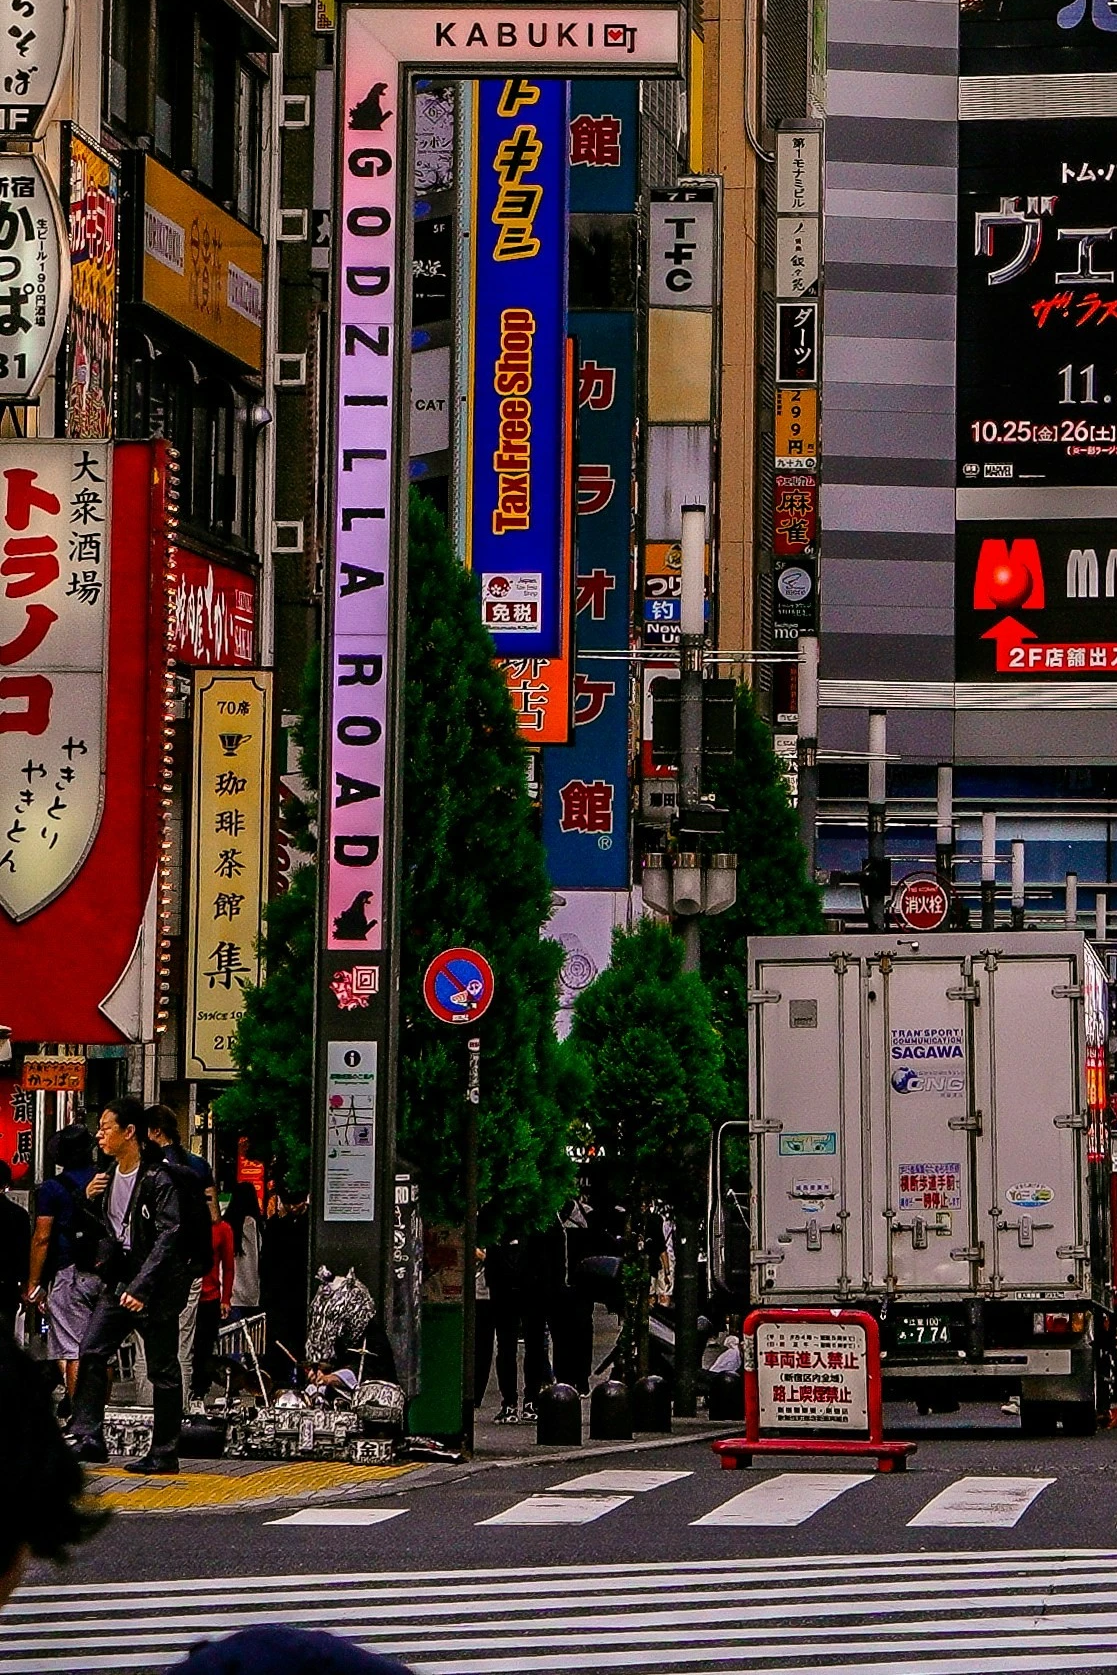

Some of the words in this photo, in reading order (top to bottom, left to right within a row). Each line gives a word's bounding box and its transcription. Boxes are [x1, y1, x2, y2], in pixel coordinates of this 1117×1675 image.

[666, 192, 697, 202] 7F
[494, 308, 536, 393] Shop
[792, 308, 813, 365] ダーツ
[336, 148, 393, 600] GODZILLA
[415, 399, 446, 412] CAT
[787, 389, 804, 455] 299円
[494, 396, 534, 472] Free
[65, 450, 105, 608] 大衆酒場
[493, 475, 533, 535] Tax
[776, 489, 815, 545] 麻雀
[0, 468, 61, 736] トラノコ
[492, 603, 533, 622] 免税
[651, 600, 674, 620] 釣
[217, 700, 251, 716] 70席
[332, 652, 384, 868] ROAD
[41, 736, 88, 850] やきとり
[212, 772, 247, 923] 珈琲茶館
[905, 894, 943, 915] 消火栓
[202, 940, 251, 992] 集
[891, 1046, 964, 1060] SAGAWA
[907, 1076, 965, 1093] CNG
[763, 1350, 860, 1370] 車両進入禁止
[772, 1384, 853, 1404] 路上喫煙禁止
